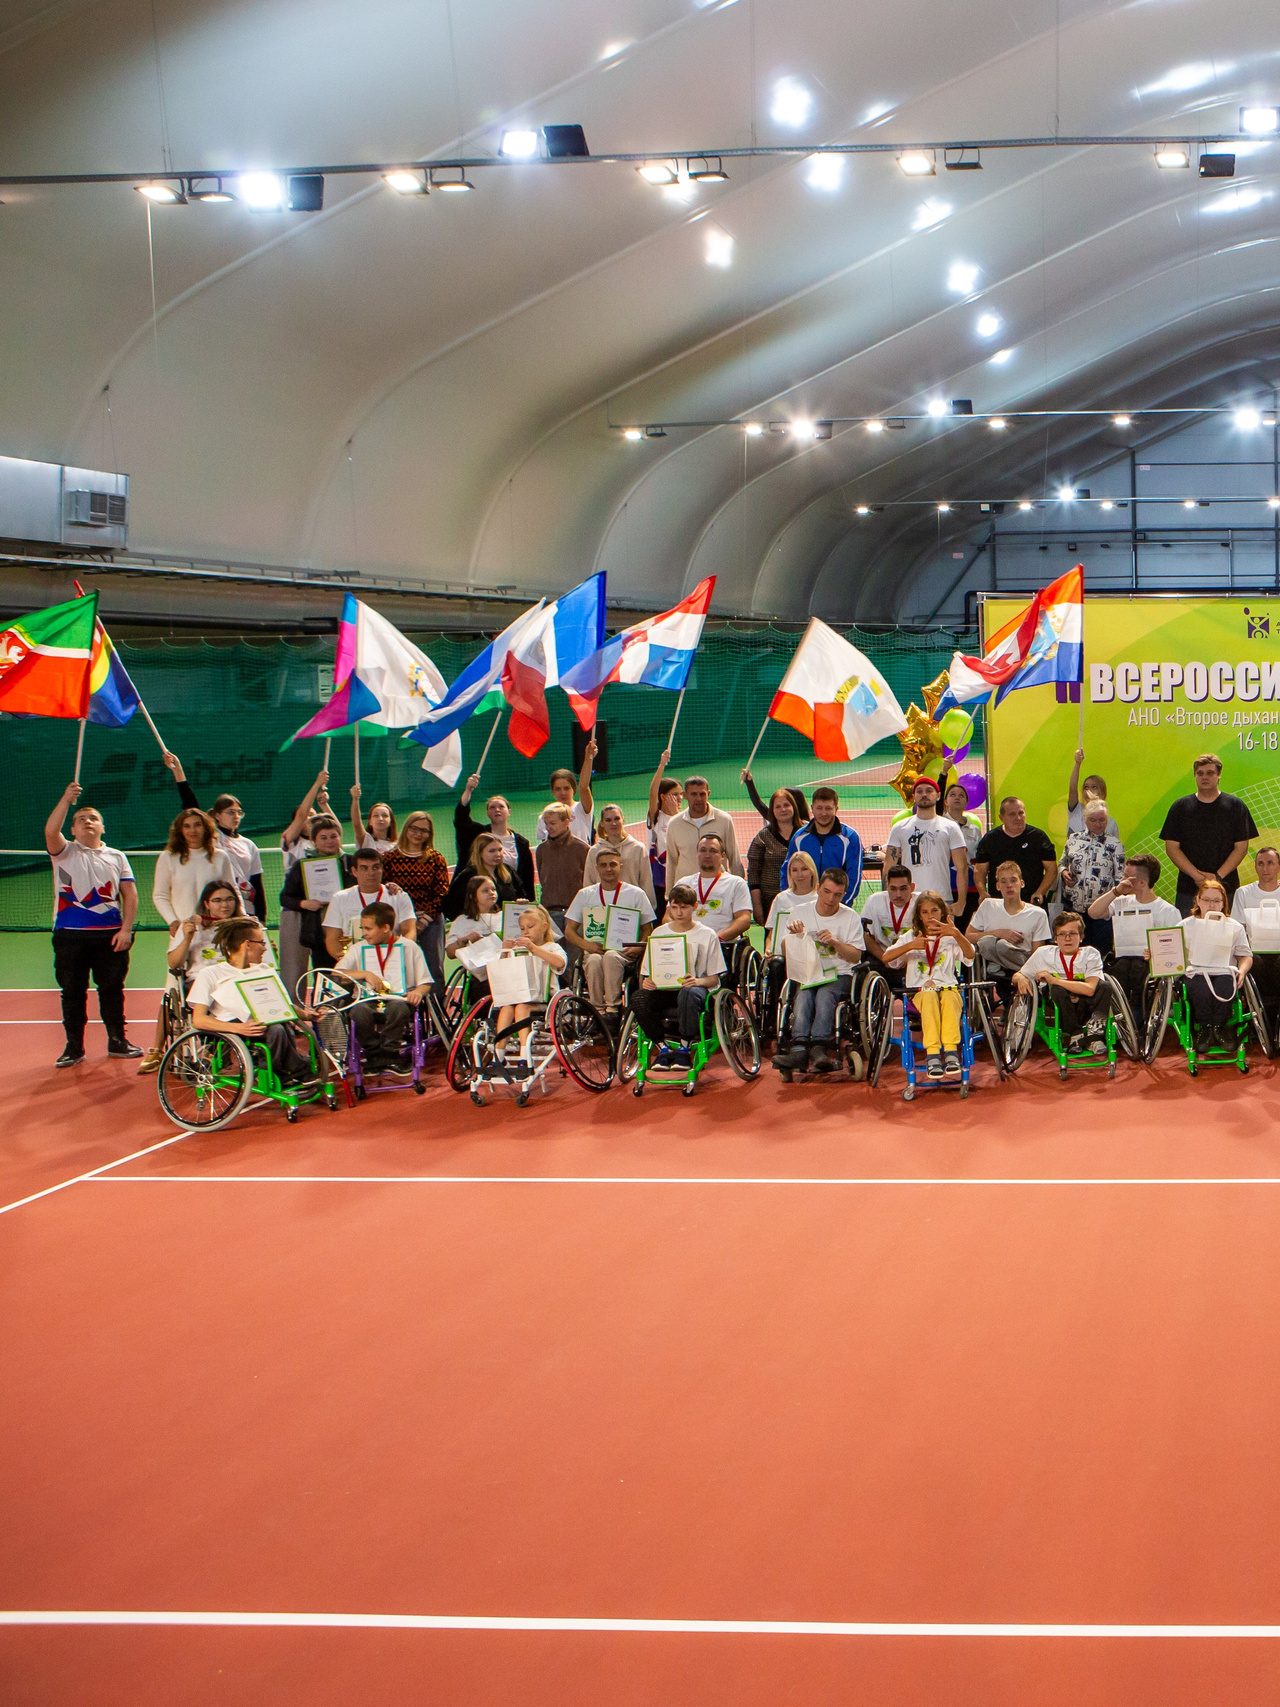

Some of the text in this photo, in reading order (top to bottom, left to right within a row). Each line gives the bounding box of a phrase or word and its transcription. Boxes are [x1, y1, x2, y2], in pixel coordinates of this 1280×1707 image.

[1127, 707, 1161, 727] АНО
[1165, 706, 1229, 730] «Второе
[1237, 731, 1278, 751] 16-18
[142, 751, 279, 793] Bbolat
